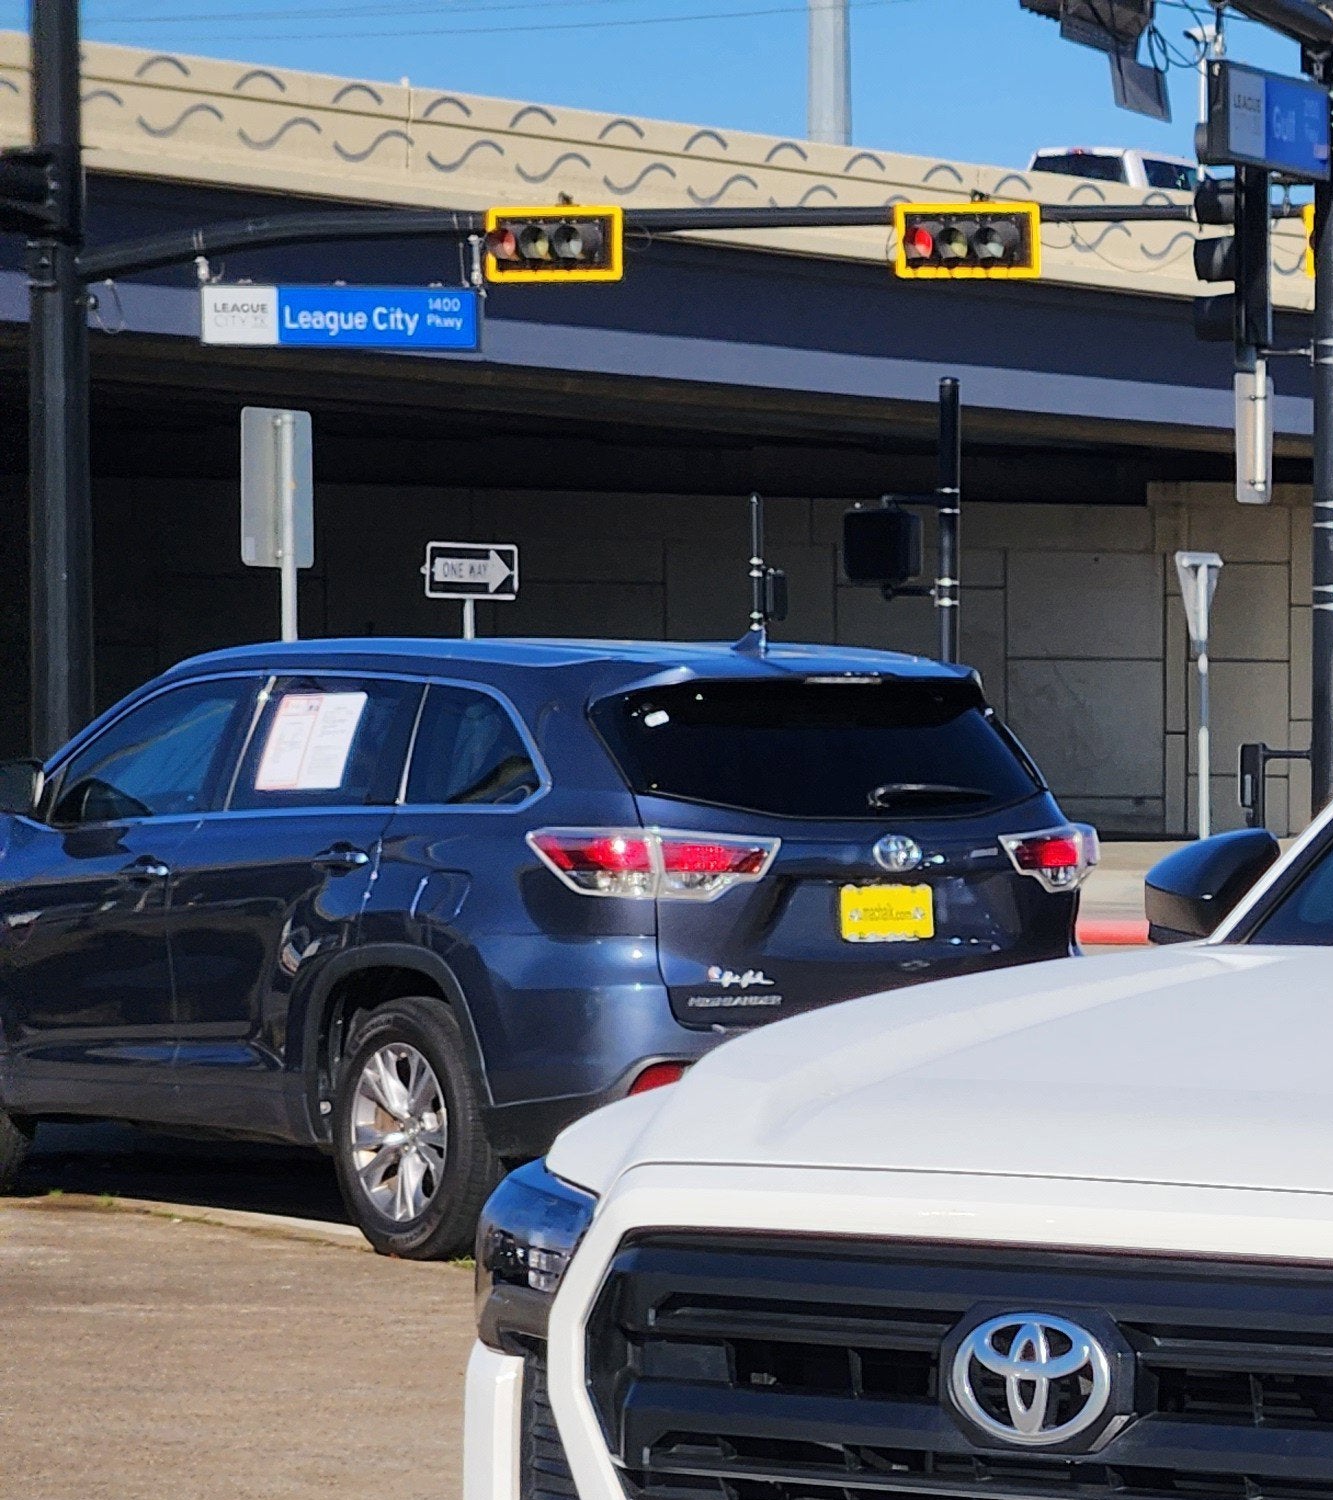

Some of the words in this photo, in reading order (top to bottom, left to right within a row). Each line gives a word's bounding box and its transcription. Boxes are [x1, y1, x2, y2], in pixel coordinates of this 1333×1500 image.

[213, 302, 269, 314] LEAGUE
[428, 297, 461, 312] 1400
[284, 305, 367, 336] League
[372, 307, 419, 336] City
[426, 314, 463, 330] Pkwy
[442, 561, 464, 579] ONE
